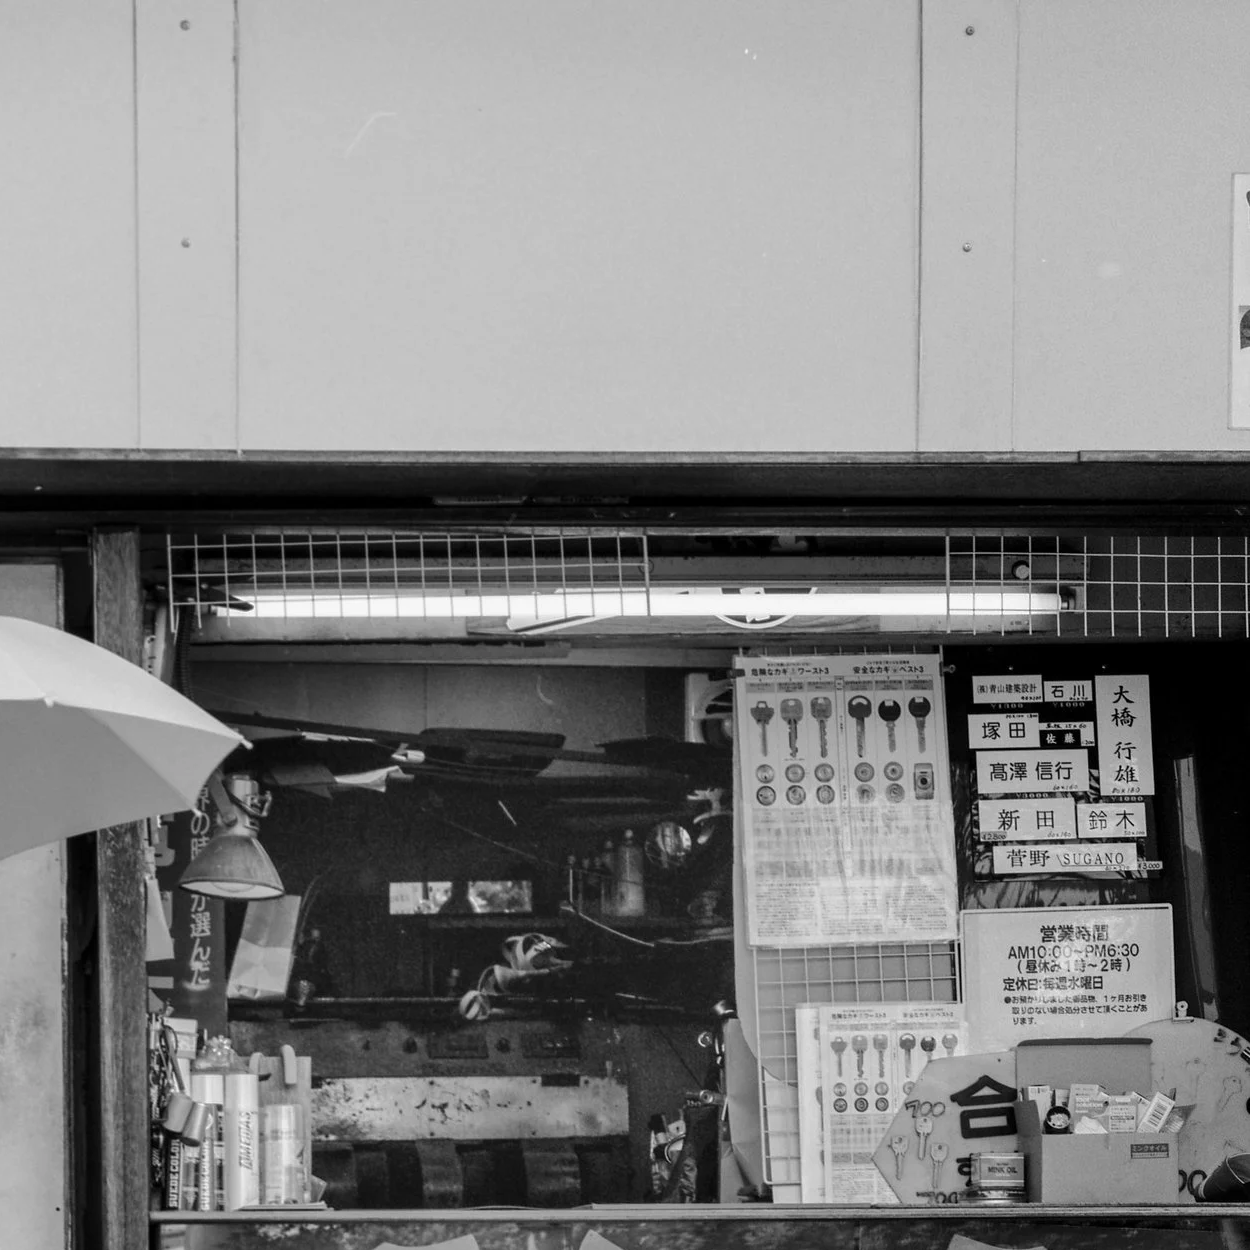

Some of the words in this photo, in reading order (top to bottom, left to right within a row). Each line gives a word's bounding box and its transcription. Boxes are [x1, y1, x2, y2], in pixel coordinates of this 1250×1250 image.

[998, 809, 1054, 831] 新田
[1089, 809, 1135, 830] 鈴木
[1063, 852, 1124, 865] SUGANO
[1040, 925, 1109, 942] 営業時間
[905, 1100, 946, 1118] 700
